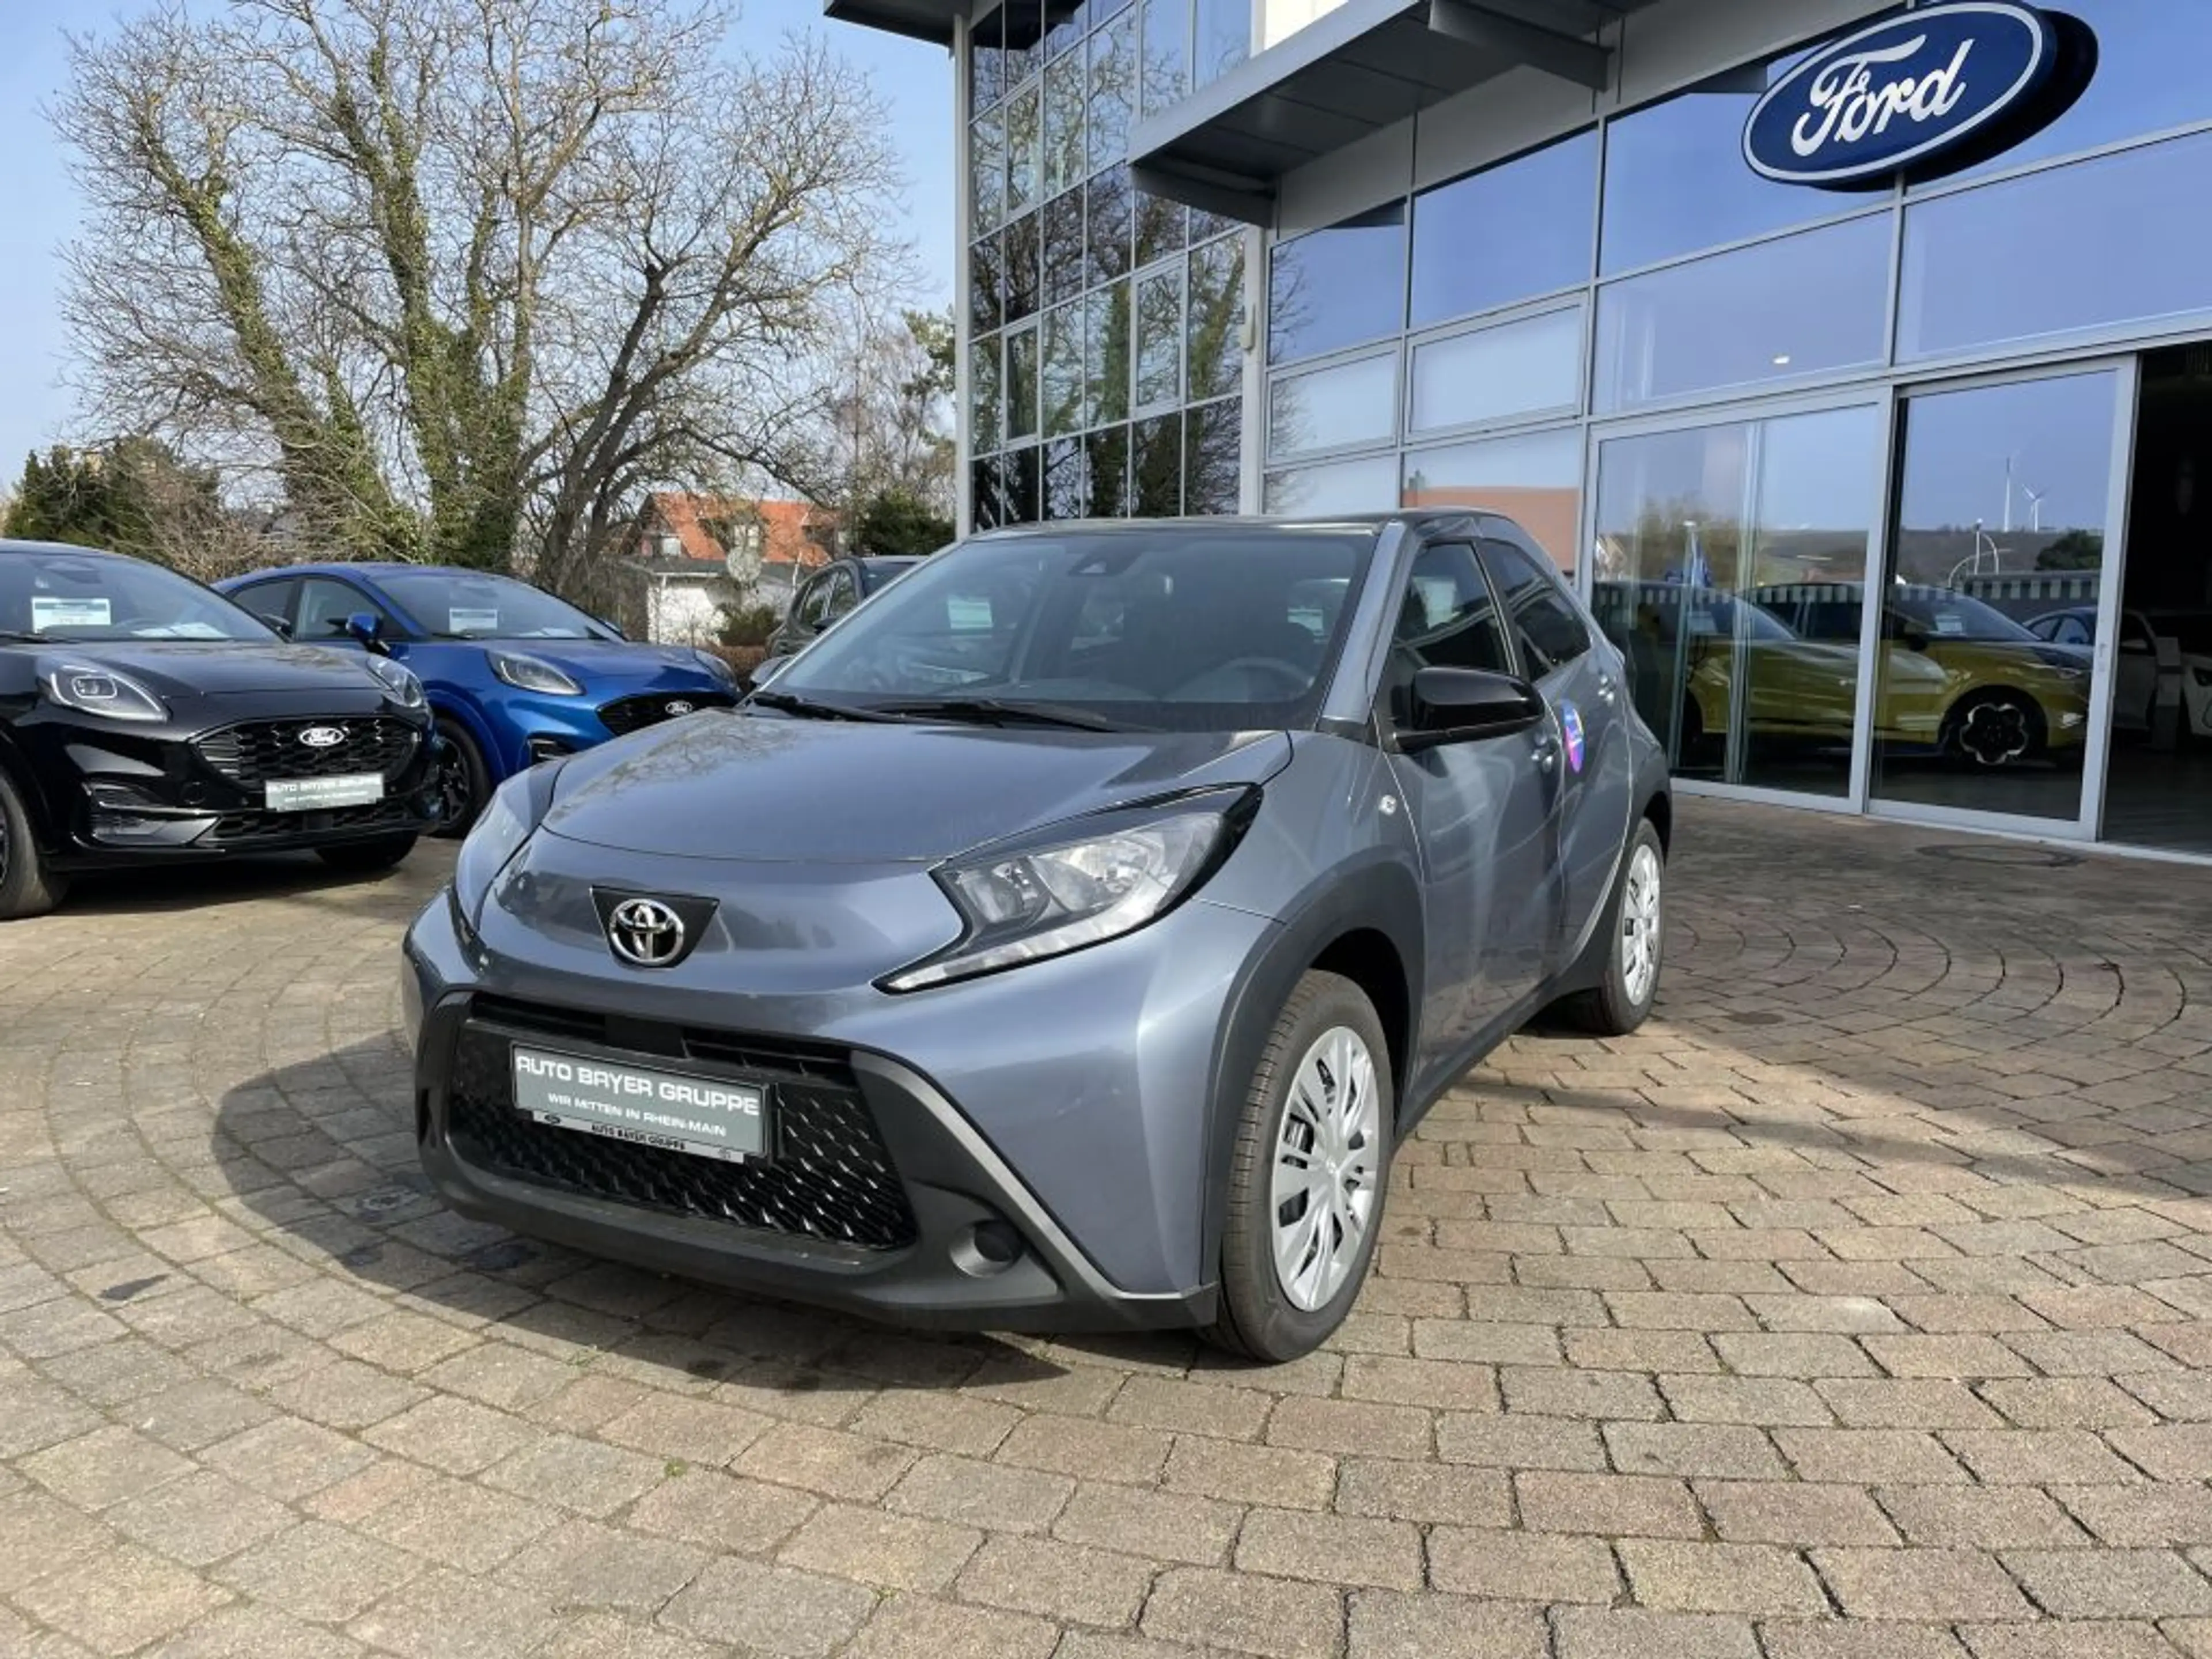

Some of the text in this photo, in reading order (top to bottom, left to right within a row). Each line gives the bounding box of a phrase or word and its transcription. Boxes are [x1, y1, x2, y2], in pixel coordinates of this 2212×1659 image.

[1791, 35, 1975, 157] Ford
[517, 1056, 760, 1116] AUTO BAYER GRUPPE
[548, 1092, 571, 1107] WIR
[574, 1097, 623, 1117] MITTEN
[625, 1108, 641, 1120] IN
